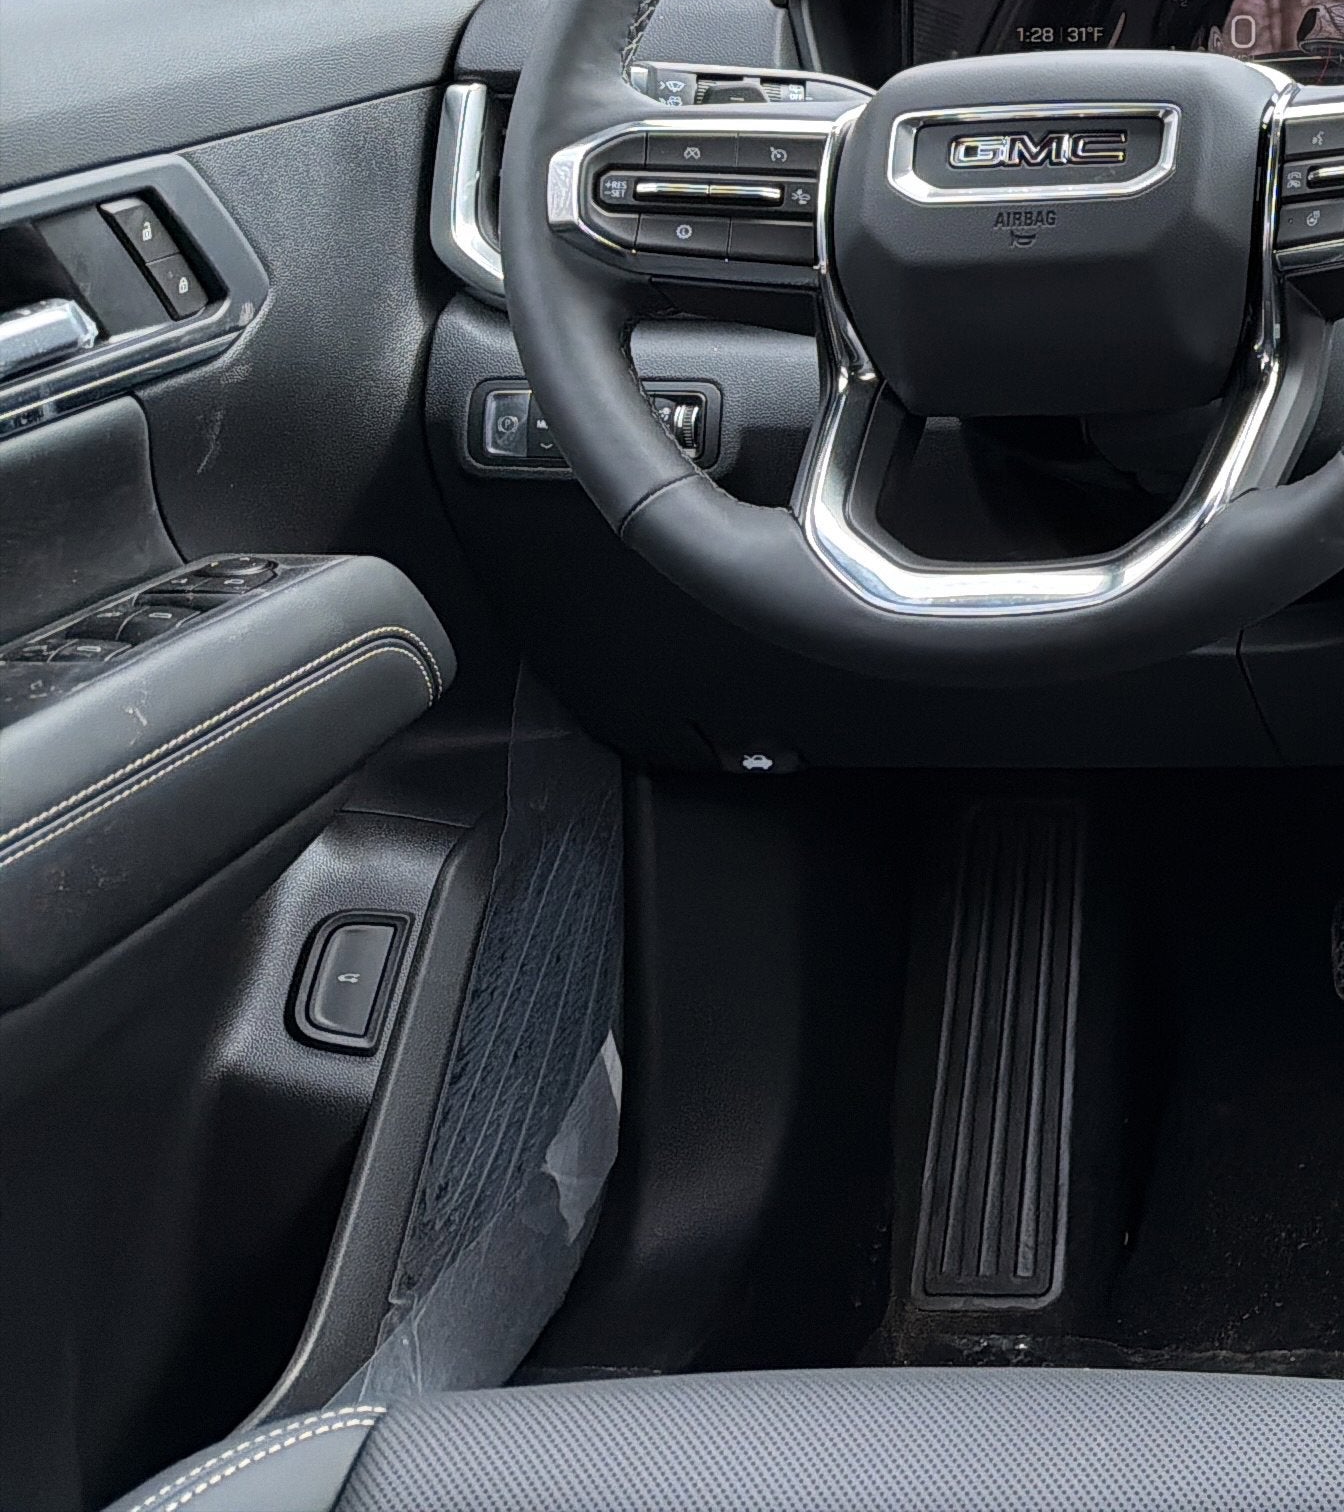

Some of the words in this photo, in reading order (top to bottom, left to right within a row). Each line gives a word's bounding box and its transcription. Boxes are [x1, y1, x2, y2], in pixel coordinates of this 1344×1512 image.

[1016, 26, 1054, 43] 1:28
[1067, 26, 1104, 43] 31°F
[948, 130, 1128, 170] GMC
[994, 210, 1057, 228] AIRBAG
